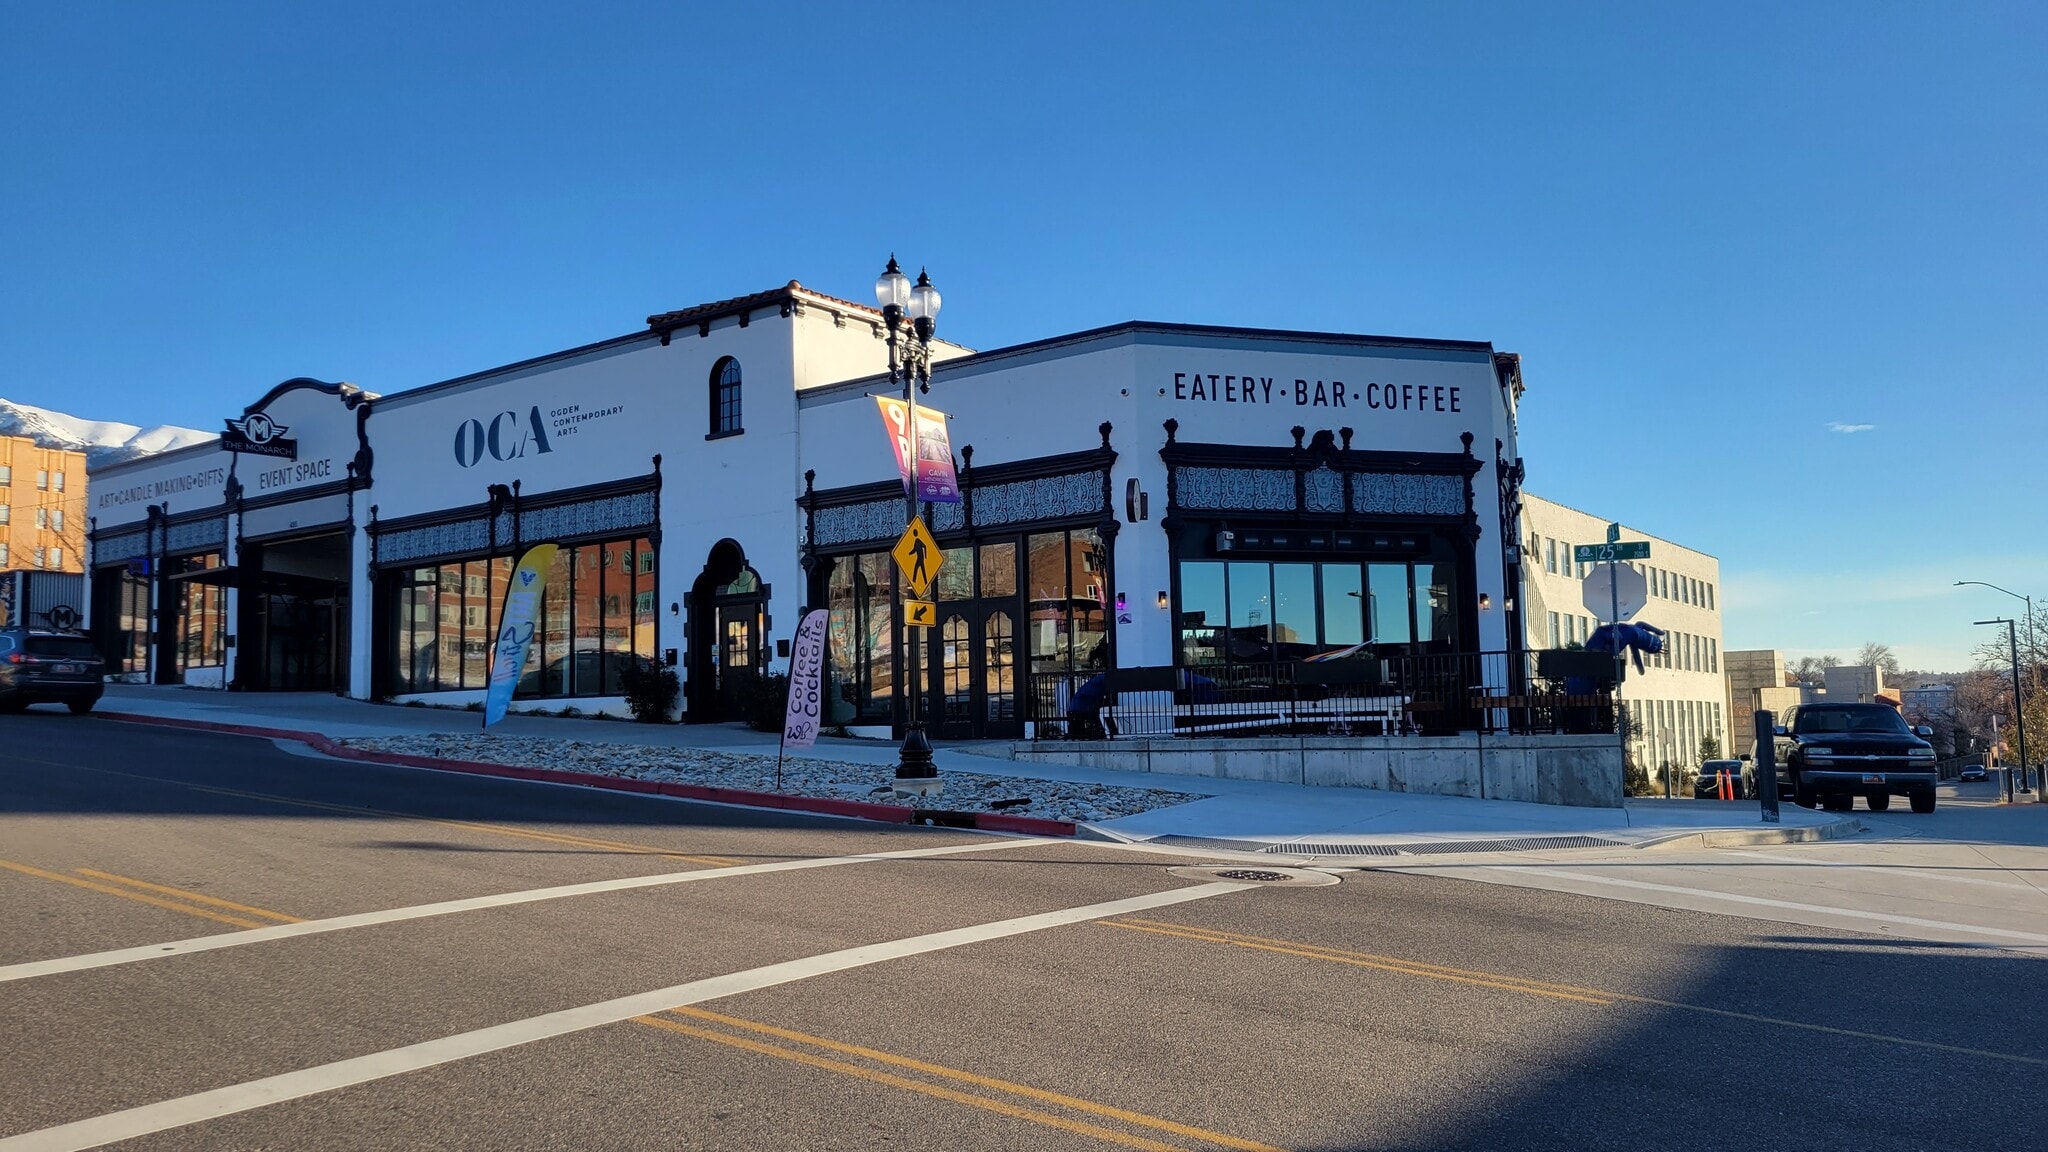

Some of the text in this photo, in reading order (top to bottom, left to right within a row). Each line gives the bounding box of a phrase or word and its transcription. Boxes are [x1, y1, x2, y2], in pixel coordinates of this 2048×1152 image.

[1174, 373, 1461, 413] EATERY BAR COFFEE
[551, 405, 580, 417] OGDEN
[553, 405, 624, 427] CONTEMPORARY
[454, 405, 553, 468] OCA
[557, 426, 578, 437] ARTS
[225, 441, 292, 456] THE MONARCH
[260, 459, 331, 490] EVENT SPACE
[928, 469, 948, 478] GAVIN
[791, 625, 812, 714] Coffee &
[804, 619, 824, 717] Cocktails
